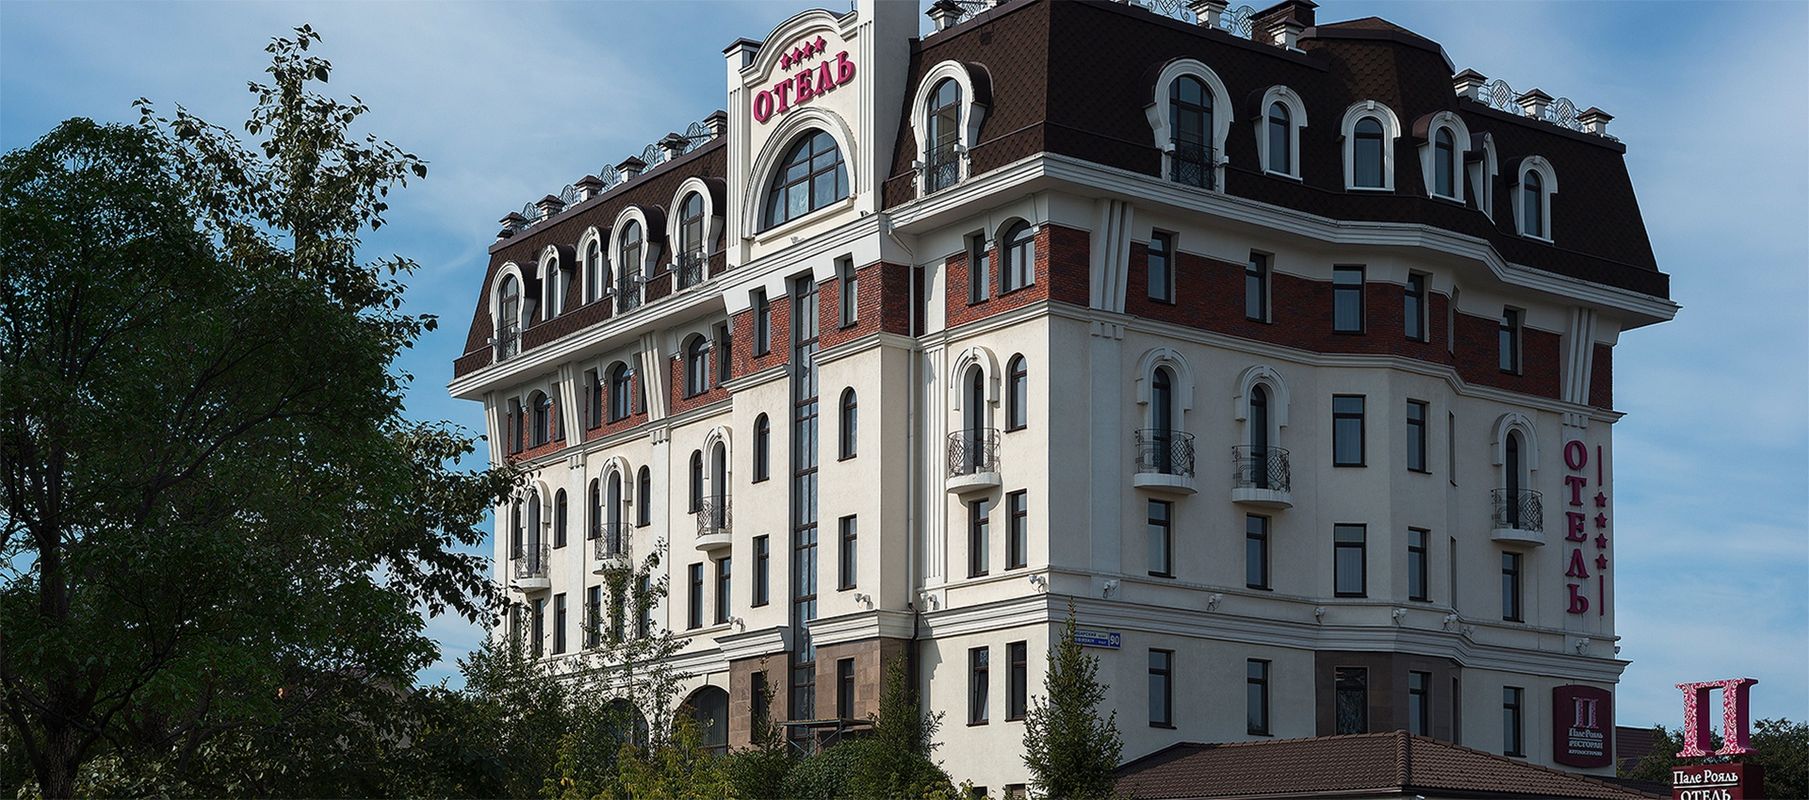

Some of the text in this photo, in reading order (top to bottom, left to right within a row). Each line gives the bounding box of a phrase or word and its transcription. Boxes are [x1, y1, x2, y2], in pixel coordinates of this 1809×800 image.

[753, 50, 856, 124] ОТЕЛЬ
[1563, 440, 1590, 615] ОТЕЛЬ
[1110, 634, 1120, 646] 90
[1673, 769, 1739, 785] Пале Рояль
[1680, 788, 1732, 800] ОТЕЛЬ
